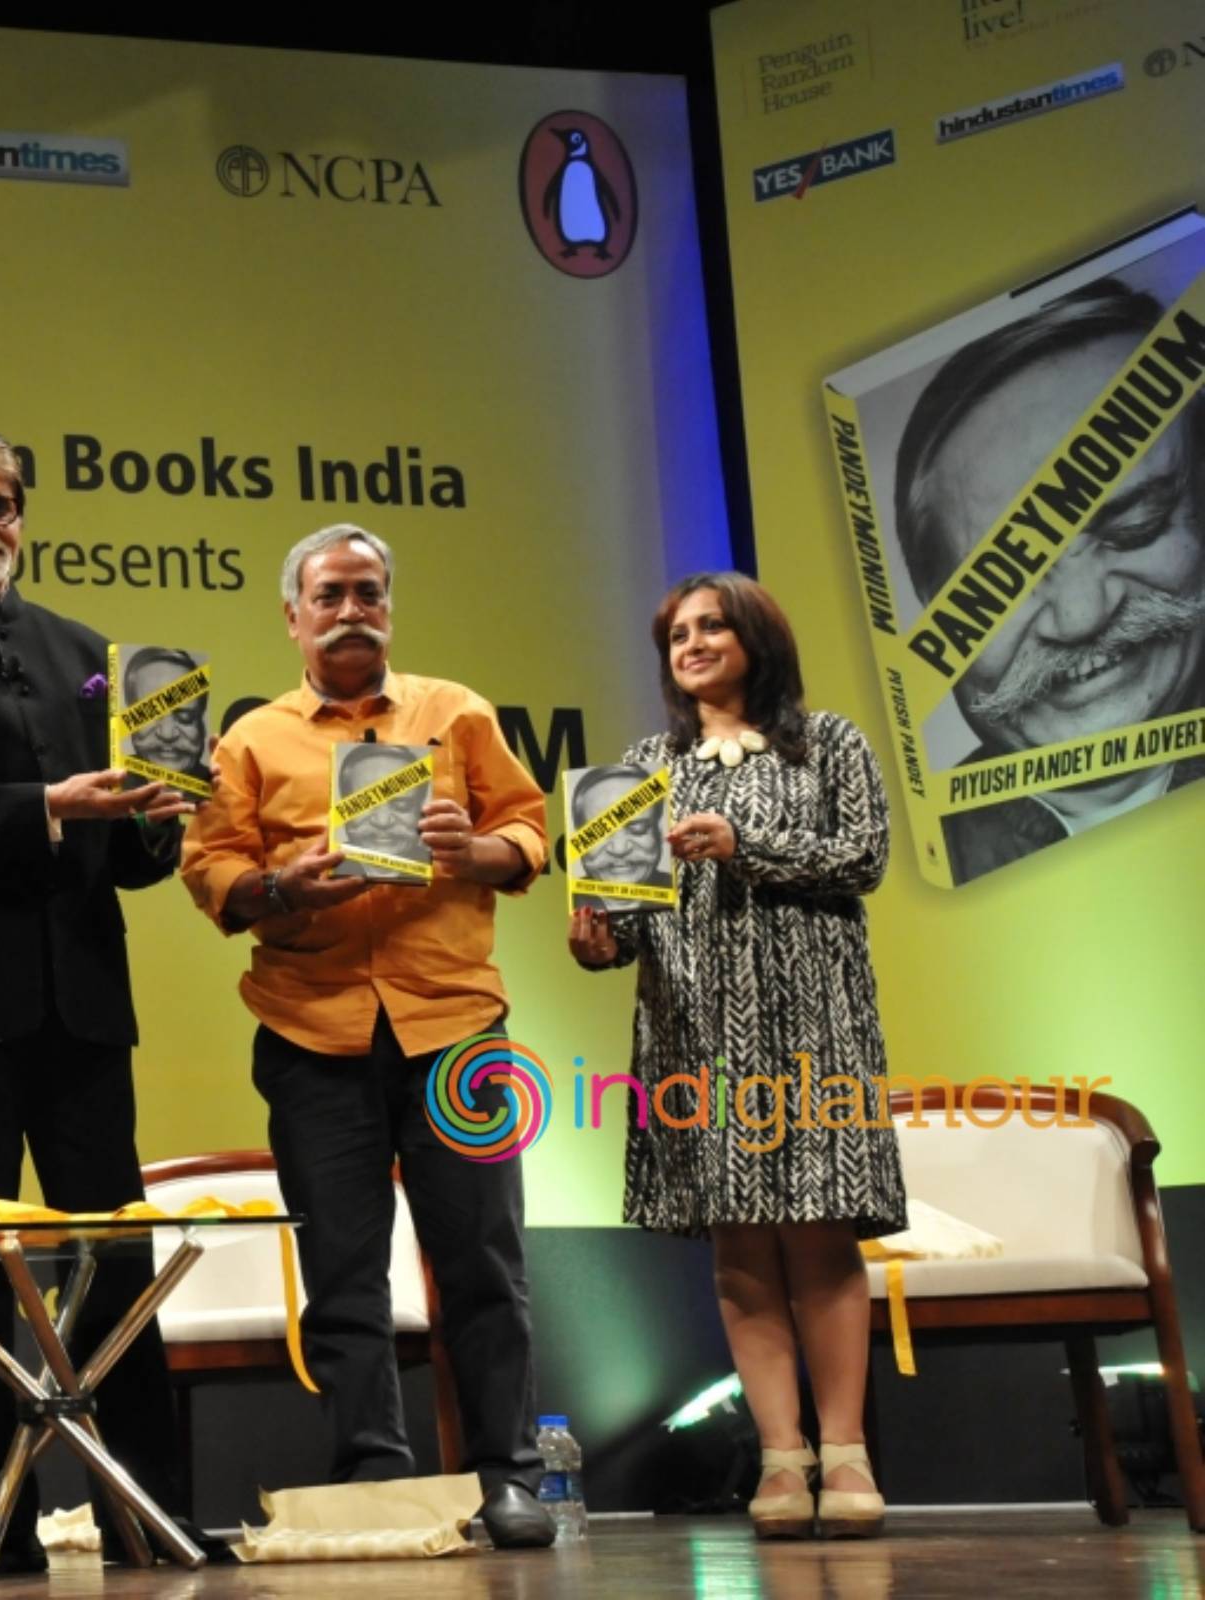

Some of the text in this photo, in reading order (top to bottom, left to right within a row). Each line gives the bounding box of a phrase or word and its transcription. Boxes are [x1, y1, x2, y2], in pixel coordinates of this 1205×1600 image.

[759, 33, 855, 73] Penguin
[760, 54, 855, 93] Random
[763, 82, 833, 114] House
[939, 71, 1119, 137] hindustantimes
[279, 152, 442, 206] NCPA
[757, 137, 892, 193] YES BANK
[65, 434, 273, 500] Books
[299, 446, 467, 508] India
[908, 309, 1205, 677] PANDEYMONIUM
[831, 413, 899, 635] PANDEYMONIUM
[17, 538, 245, 590] resents
[122, 670, 209, 730] PANDEYMONIUM
[887, 667, 926, 798] PIYUSH PANDEY
[336, 763, 431, 820] PANDEYMONIUM
[951, 756, 1016, 803] PIYUSH
[1023, 743, 1094, 783] PANDEY
[1102, 736, 1127, 767] ON
[571, 778, 666, 853] PANDEYMONIUM
